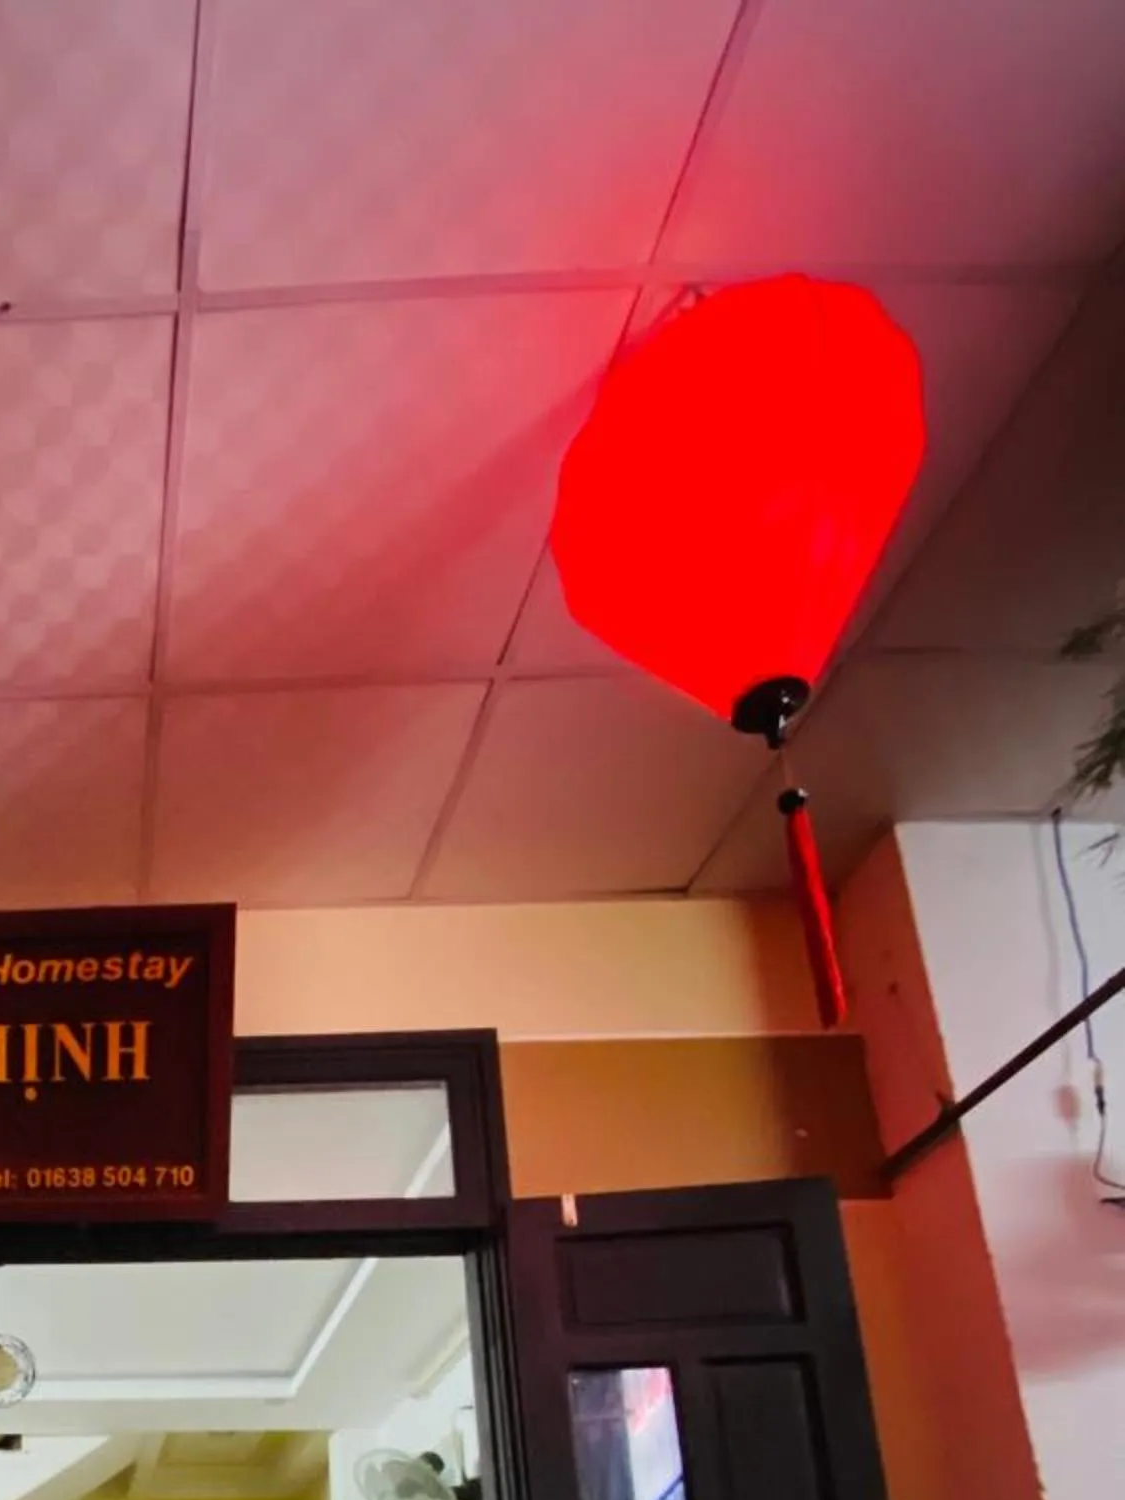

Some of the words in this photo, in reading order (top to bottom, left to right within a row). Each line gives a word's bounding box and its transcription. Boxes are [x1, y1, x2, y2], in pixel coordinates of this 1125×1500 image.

[27, 1166, 96, 1189] 01638
[102, 1165, 148, 1188] 504
[154, 1165, 196, 1188] 710
